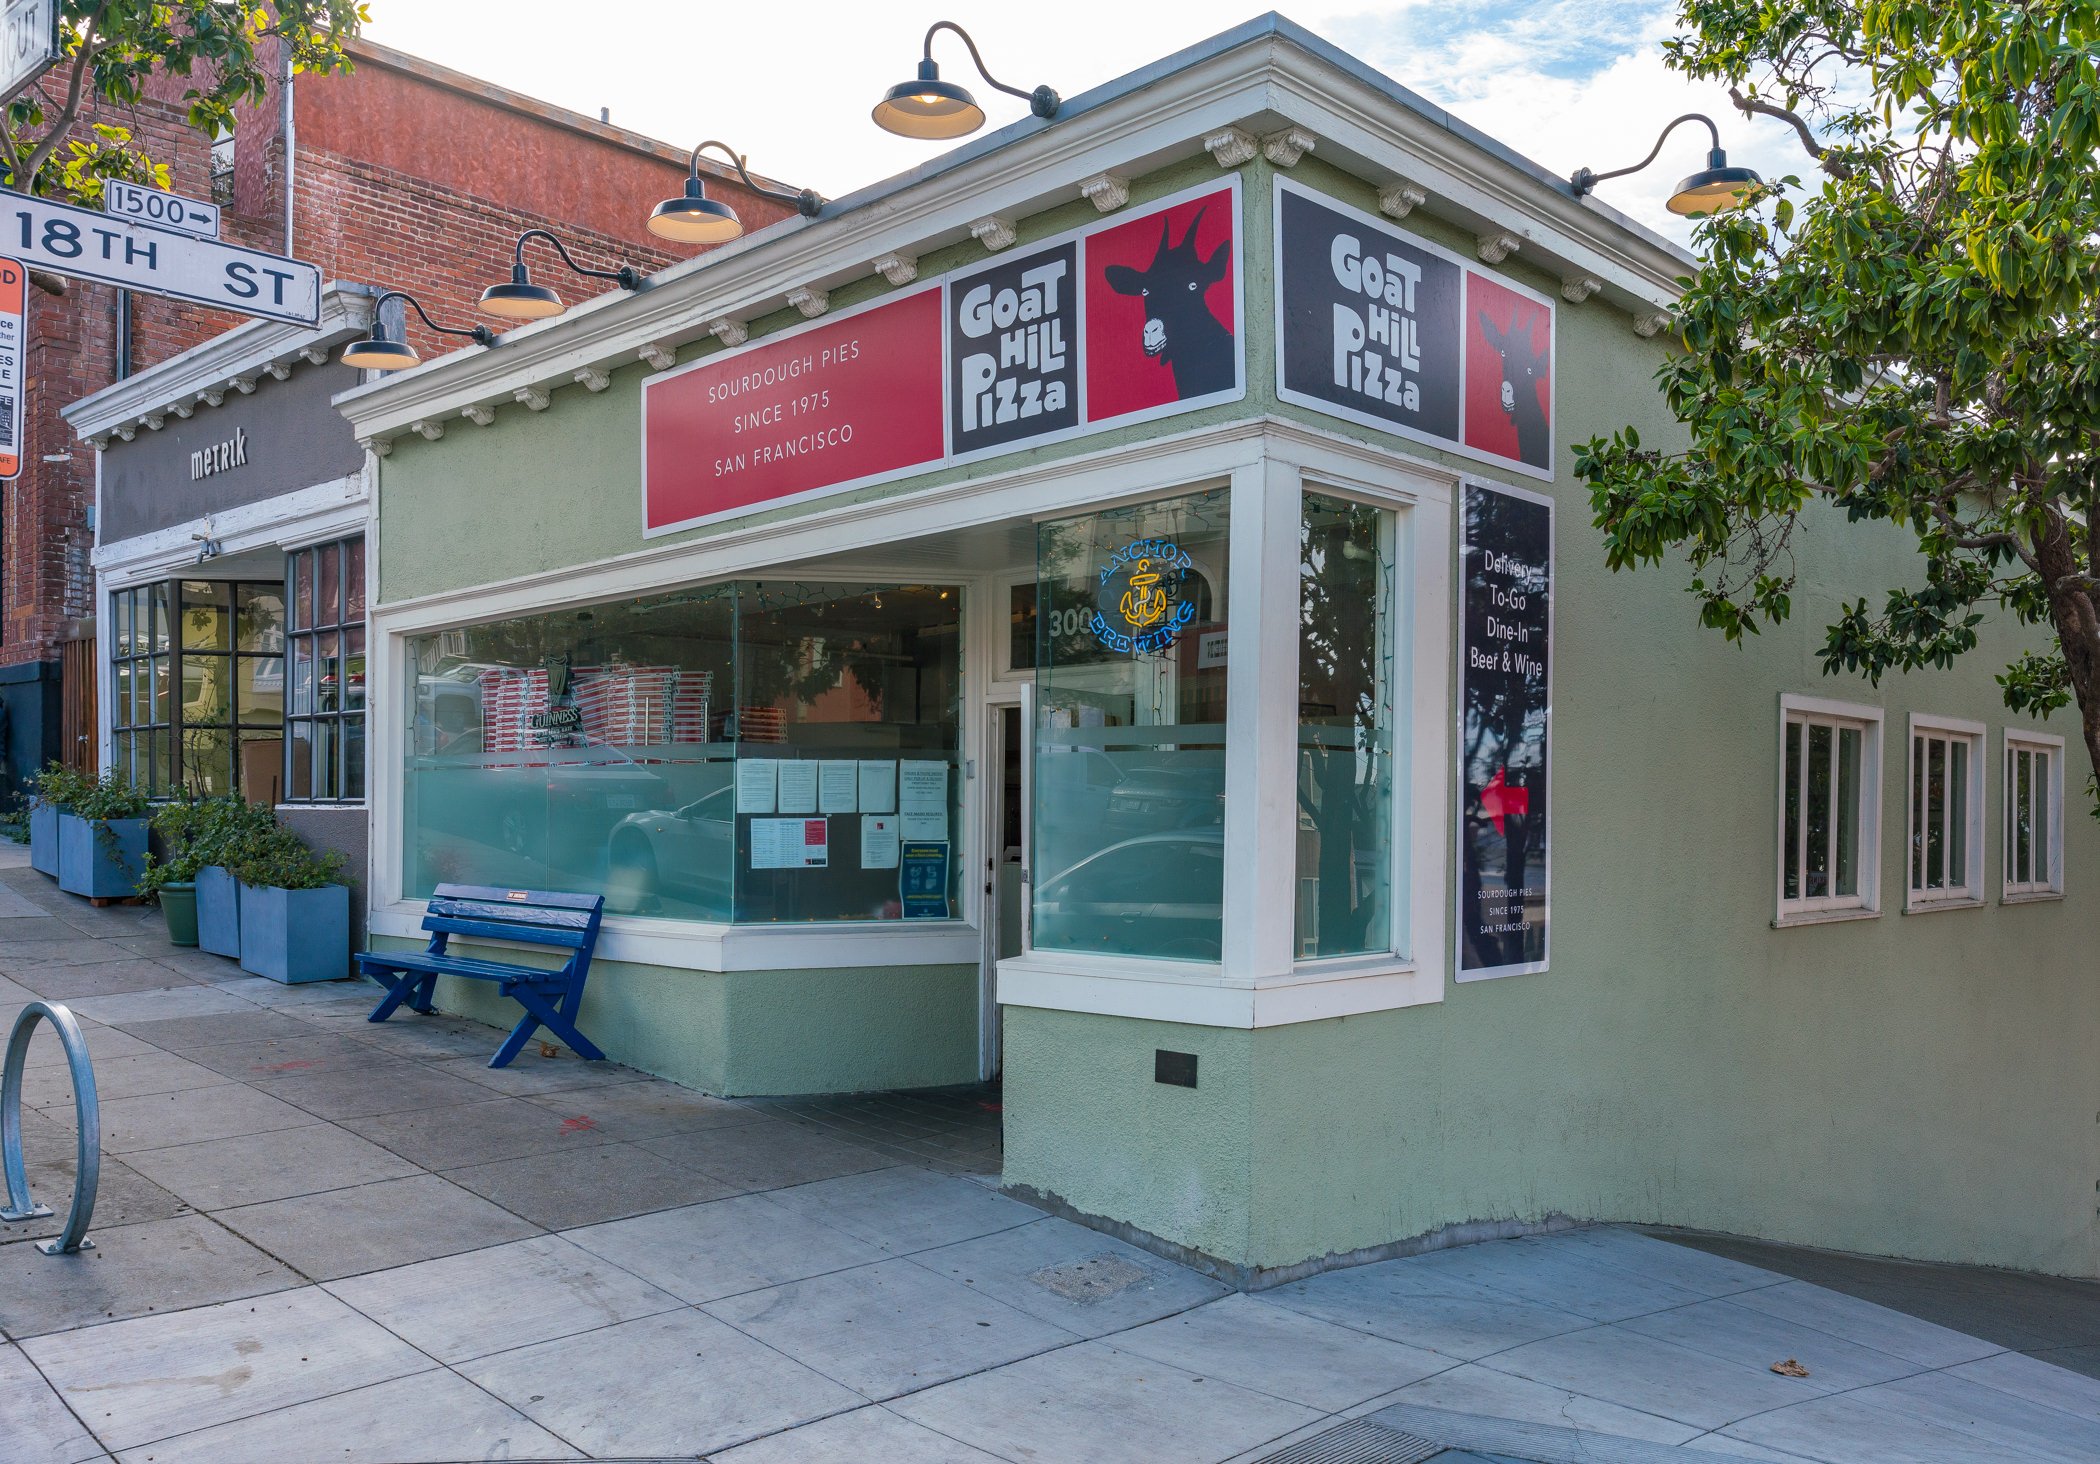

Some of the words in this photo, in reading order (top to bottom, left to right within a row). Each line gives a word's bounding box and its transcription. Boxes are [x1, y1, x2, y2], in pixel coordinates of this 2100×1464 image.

[115, 186, 184, 224] 1500
[16, 211, 157, 271] 18TH
[223, 262, 295, 306] ST
[708, 355, 813, 404] SOURDOUGH
[822, 340, 859, 368] PIES
[734, 404, 782, 434] SINCE
[791, 390, 829, 416] 1975
[715, 453, 745, 477] SAN
[754, 424, 853, 467] FRANCISCO
[1100, 539, 1192, 586] ANCHOR
[1484, 549, 1533, 585] Delivery
[1489, 583, 1526, 611] To-Go
[1049, 606, 1093, 638] 300
[1089, 601, 1195, 653] BREWING
[1487, 615, 1528, 643] Dine-In
[1471, 646, 1498, 670] Beer
[1502, 651, 1511, 673] &
[1514, 652, 1543, 677] Wine
[531, 706, 578, 728] GUINNESS
[1477, 888, 1517, 899] SOURDOUGH
[1519, 888, 1533, 897] PIES
[1489, 906, 1508, 916] SINCE
[1510, 905, 1524, 914] 1975
[1480, 925, 1493, 934] SAN
[1495, 921, 1531, 933] FRANCISCO
